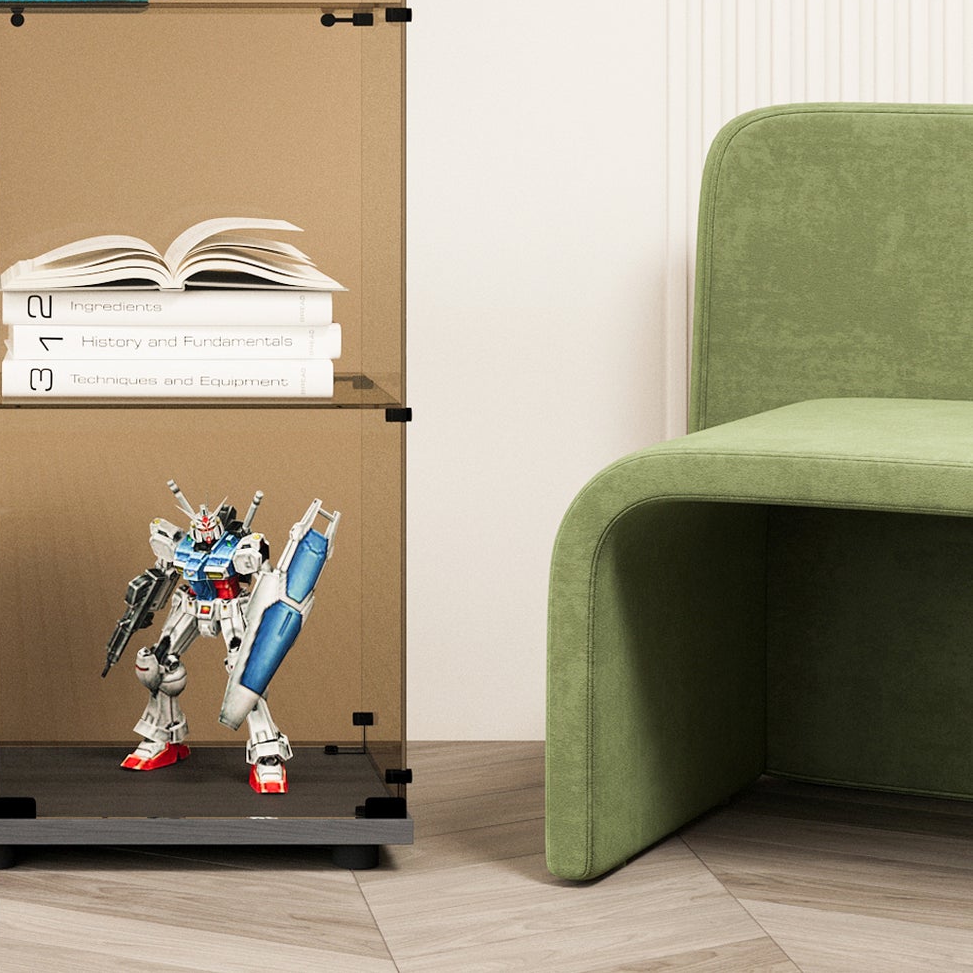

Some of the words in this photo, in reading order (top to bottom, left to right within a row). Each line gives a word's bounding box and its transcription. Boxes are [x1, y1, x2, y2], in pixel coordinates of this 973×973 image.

[27, 294, 52, 319] 2
[70, 301, 162, 313] Ingredients
[39, 336, 63, 351] 1
[81, 336, 142, 350] History
[147, 336, 177, 348] and
[183, 336, 293, 347] Fundamentals
[30, 368, 53, 391] 3
[70, 374, 158, 386] Techniques
[163, 376, 194, 386] and
[200, 376, 289, 388] Equipment
